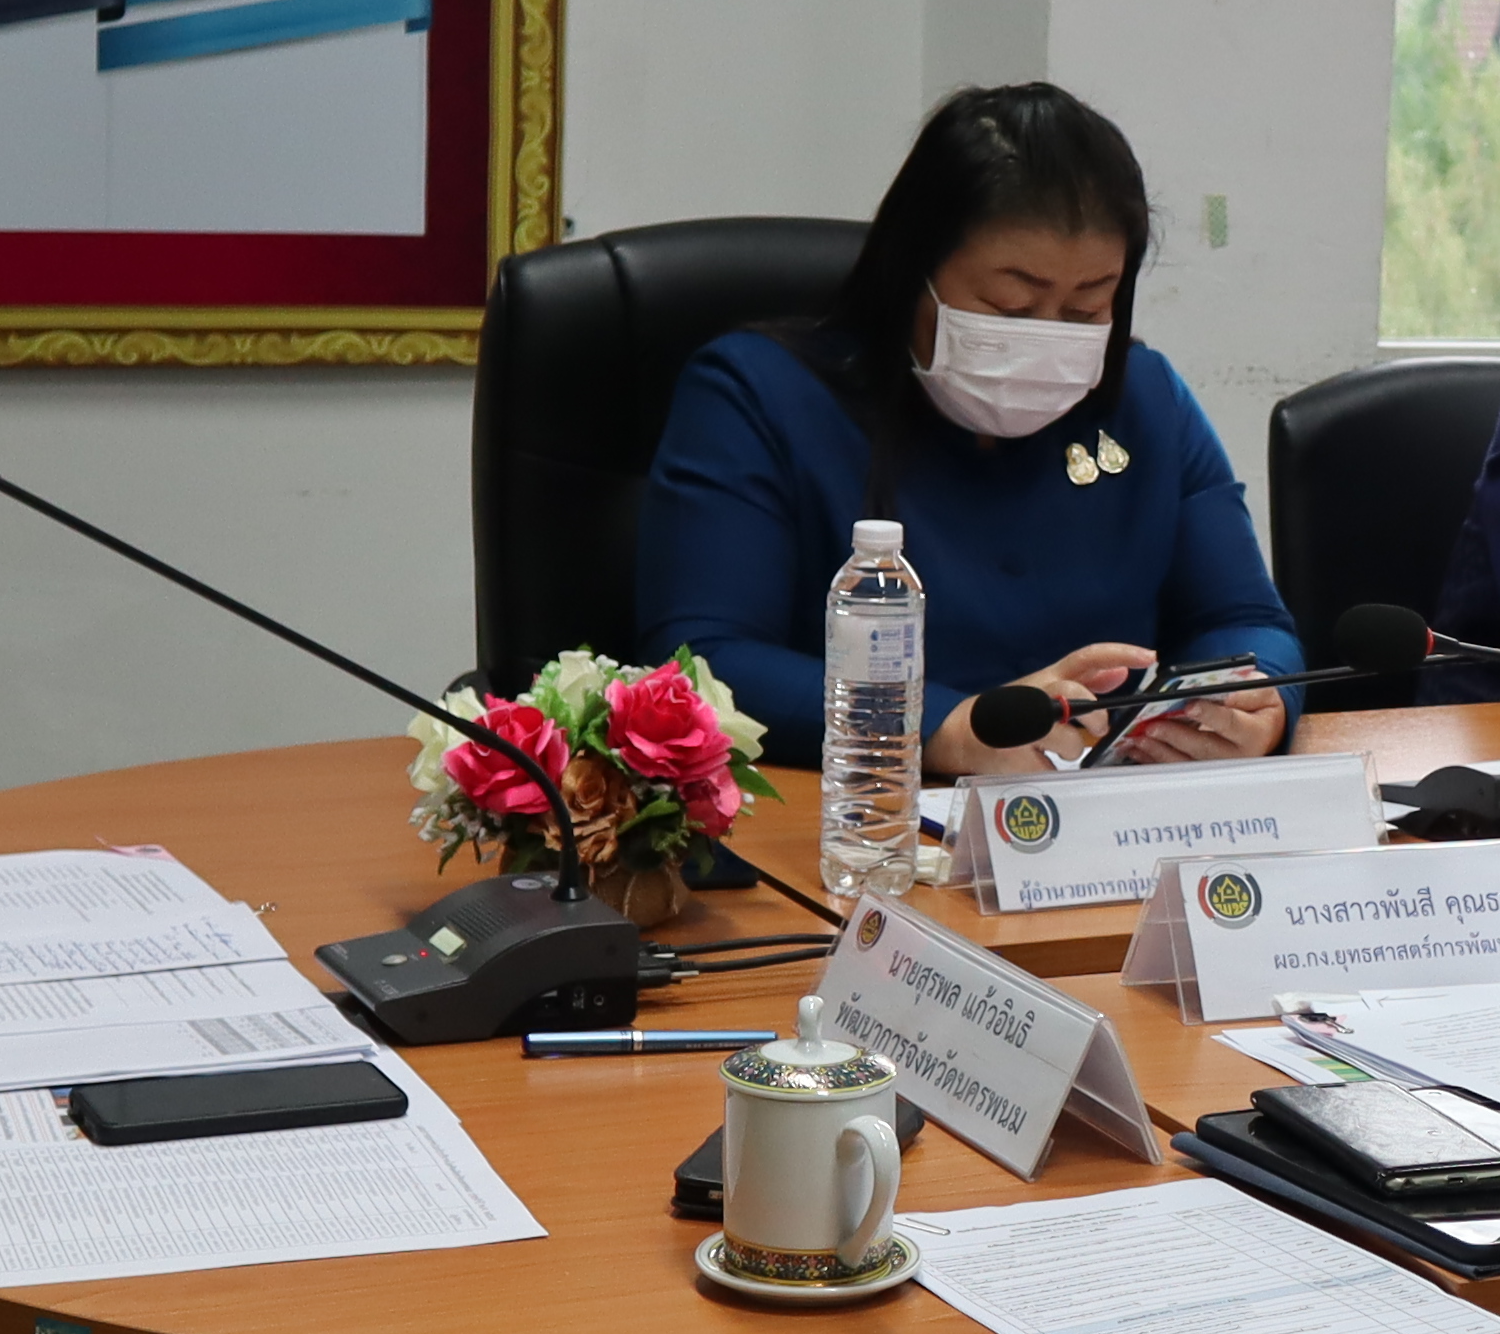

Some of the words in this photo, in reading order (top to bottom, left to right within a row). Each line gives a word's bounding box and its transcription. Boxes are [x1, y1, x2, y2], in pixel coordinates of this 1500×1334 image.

[1113, 822, 1204, 851] นางวรนุช
[1207, 813, 1279, 844] กรุงเกตุ
[1284, 884, 1436, 927] นางสาวพันสี
[888, 949, 963, 1008] นายสุรพล
[961, 985, 1035, 1049] แก้วอินธิ
[834, 992, 1028, 1136] พัฒนาการจังหวัดนครพนม
